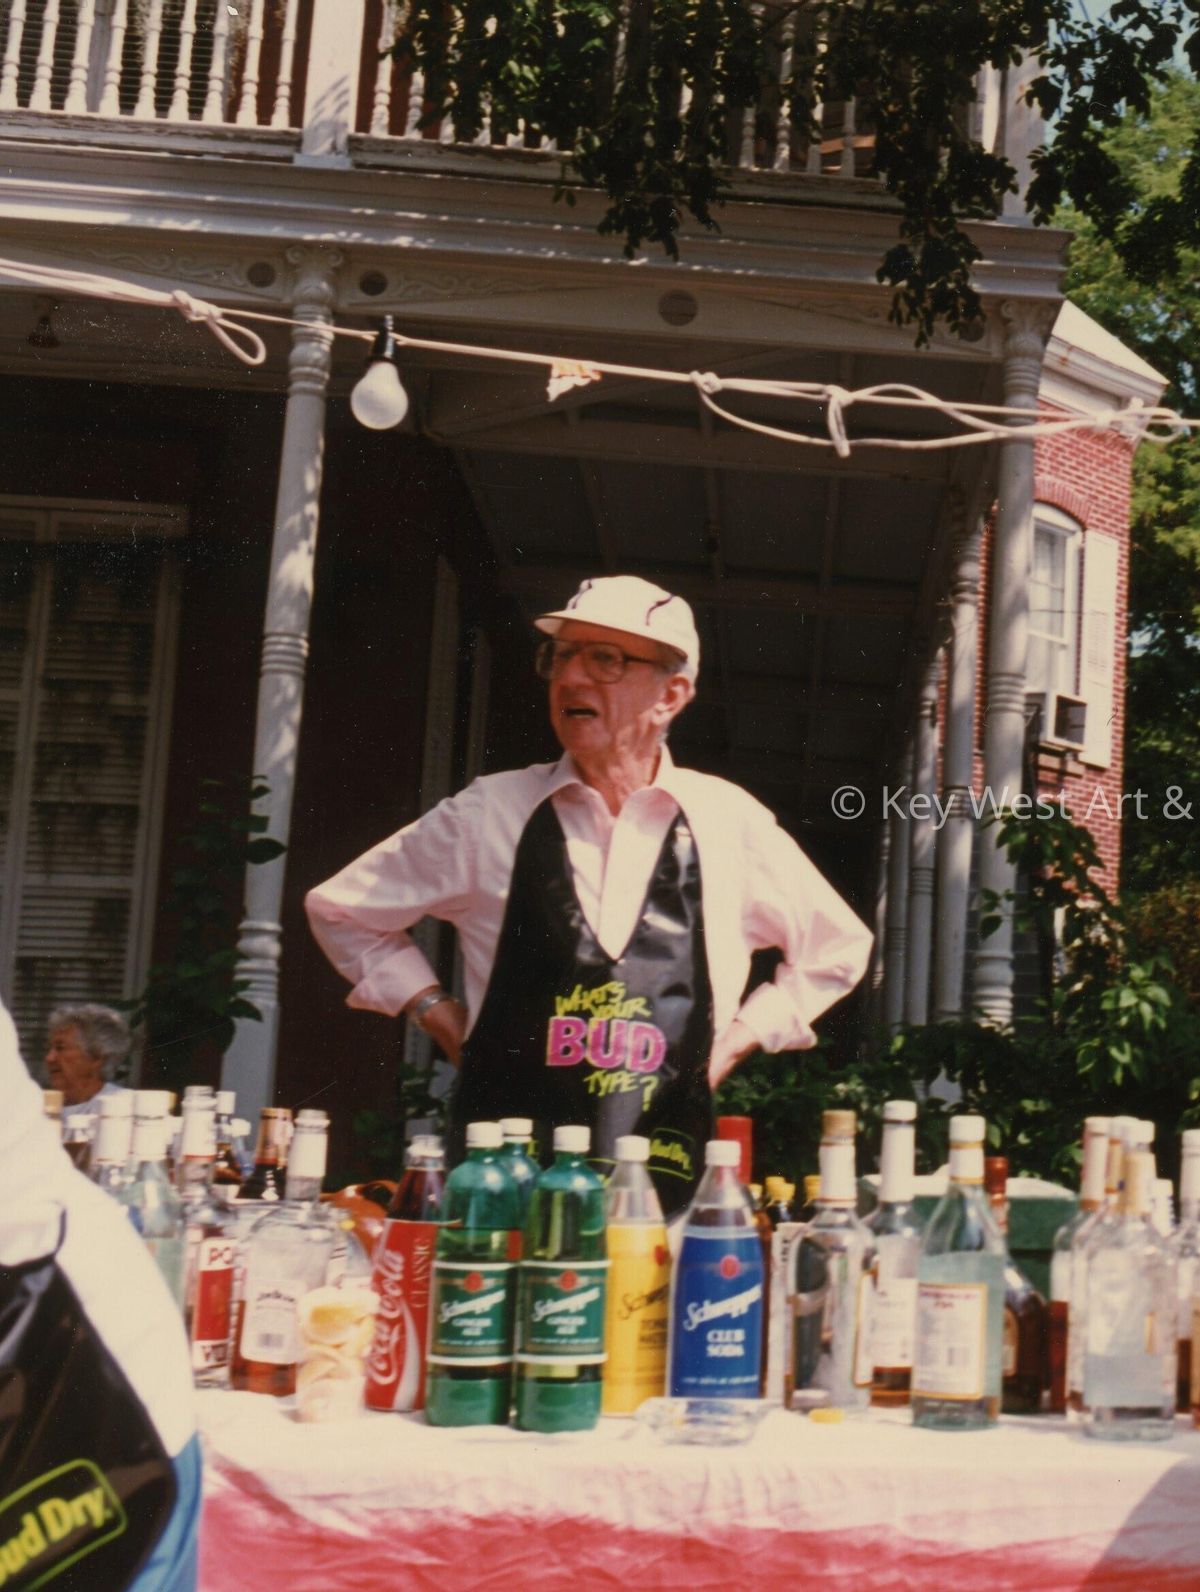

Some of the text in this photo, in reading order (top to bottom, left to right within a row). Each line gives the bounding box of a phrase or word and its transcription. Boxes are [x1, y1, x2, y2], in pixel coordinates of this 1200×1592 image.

[545, 1015, 667, 1073] BUD
[411, 1237, 432, 1309] CLASSIC
[0, 1487, 105, 1588] ud Dry
